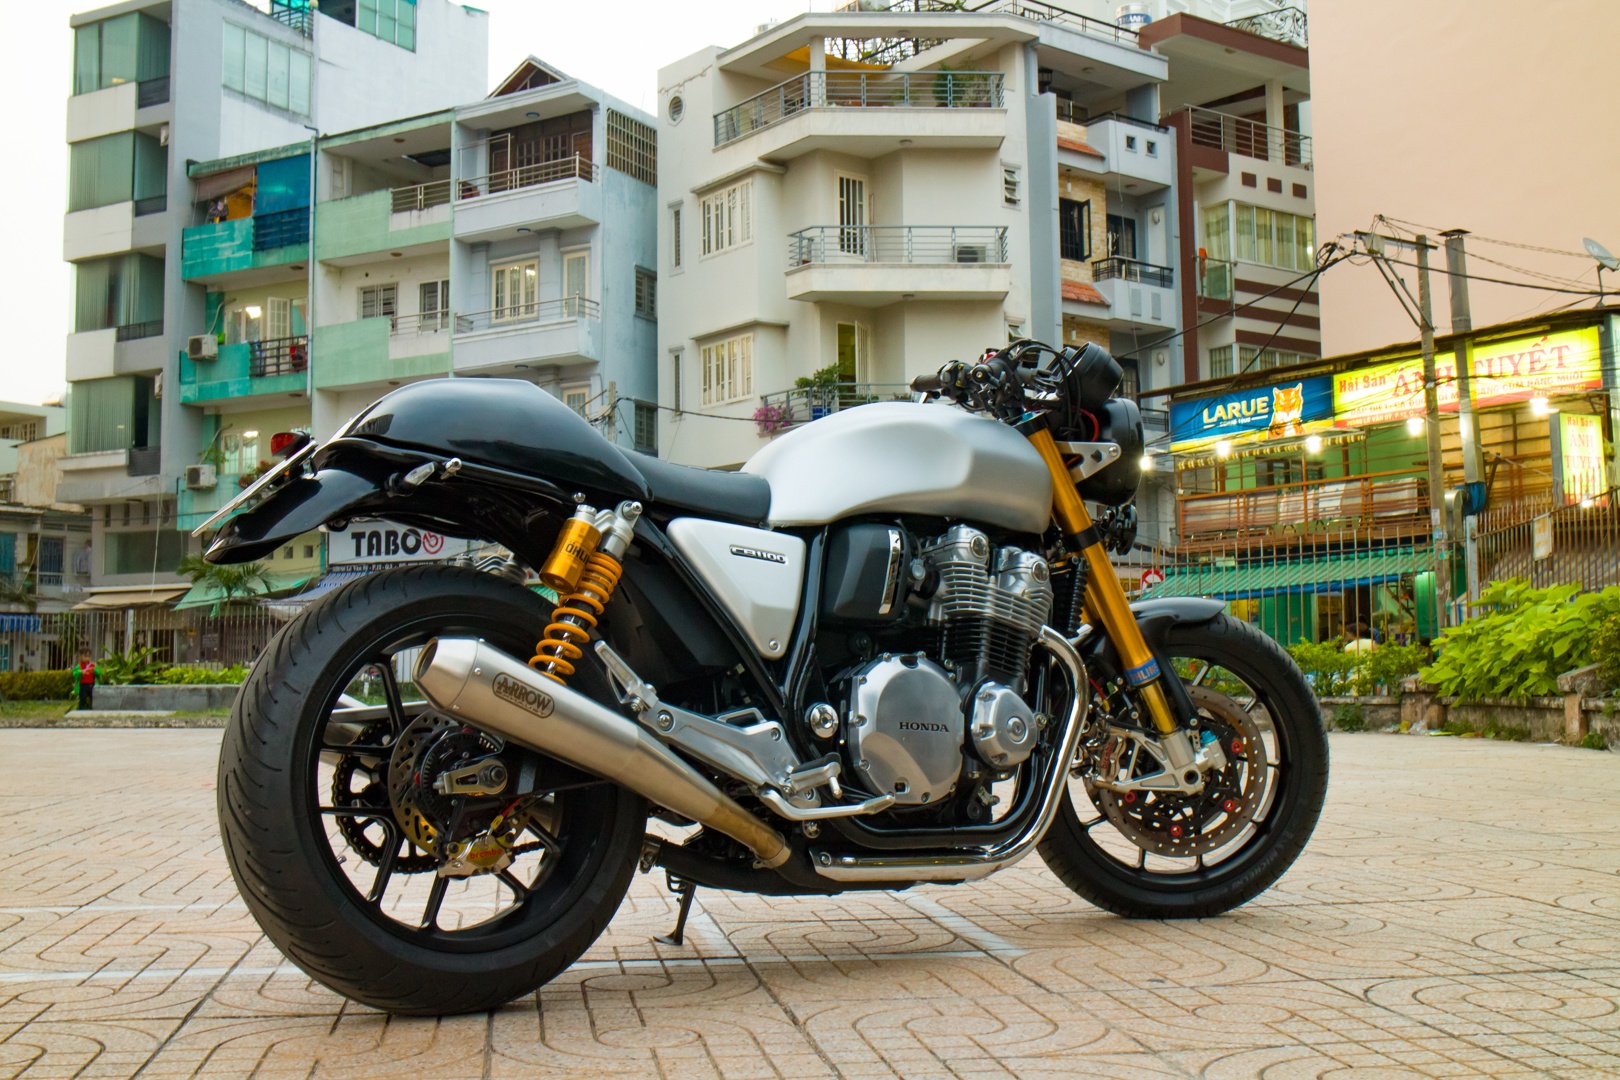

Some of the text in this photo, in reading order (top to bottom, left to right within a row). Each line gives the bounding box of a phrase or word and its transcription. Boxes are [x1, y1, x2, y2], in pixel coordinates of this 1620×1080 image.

[1203, 396, 1270, 424] LARUE
[351, 528, 422, 557] TABO
[731, 546, 786, 562] CB1100
[497, 677, 552, 712] ARROW
[899, 721, 950, 733] HONDA
[470, 848, 503, 860] brembo
